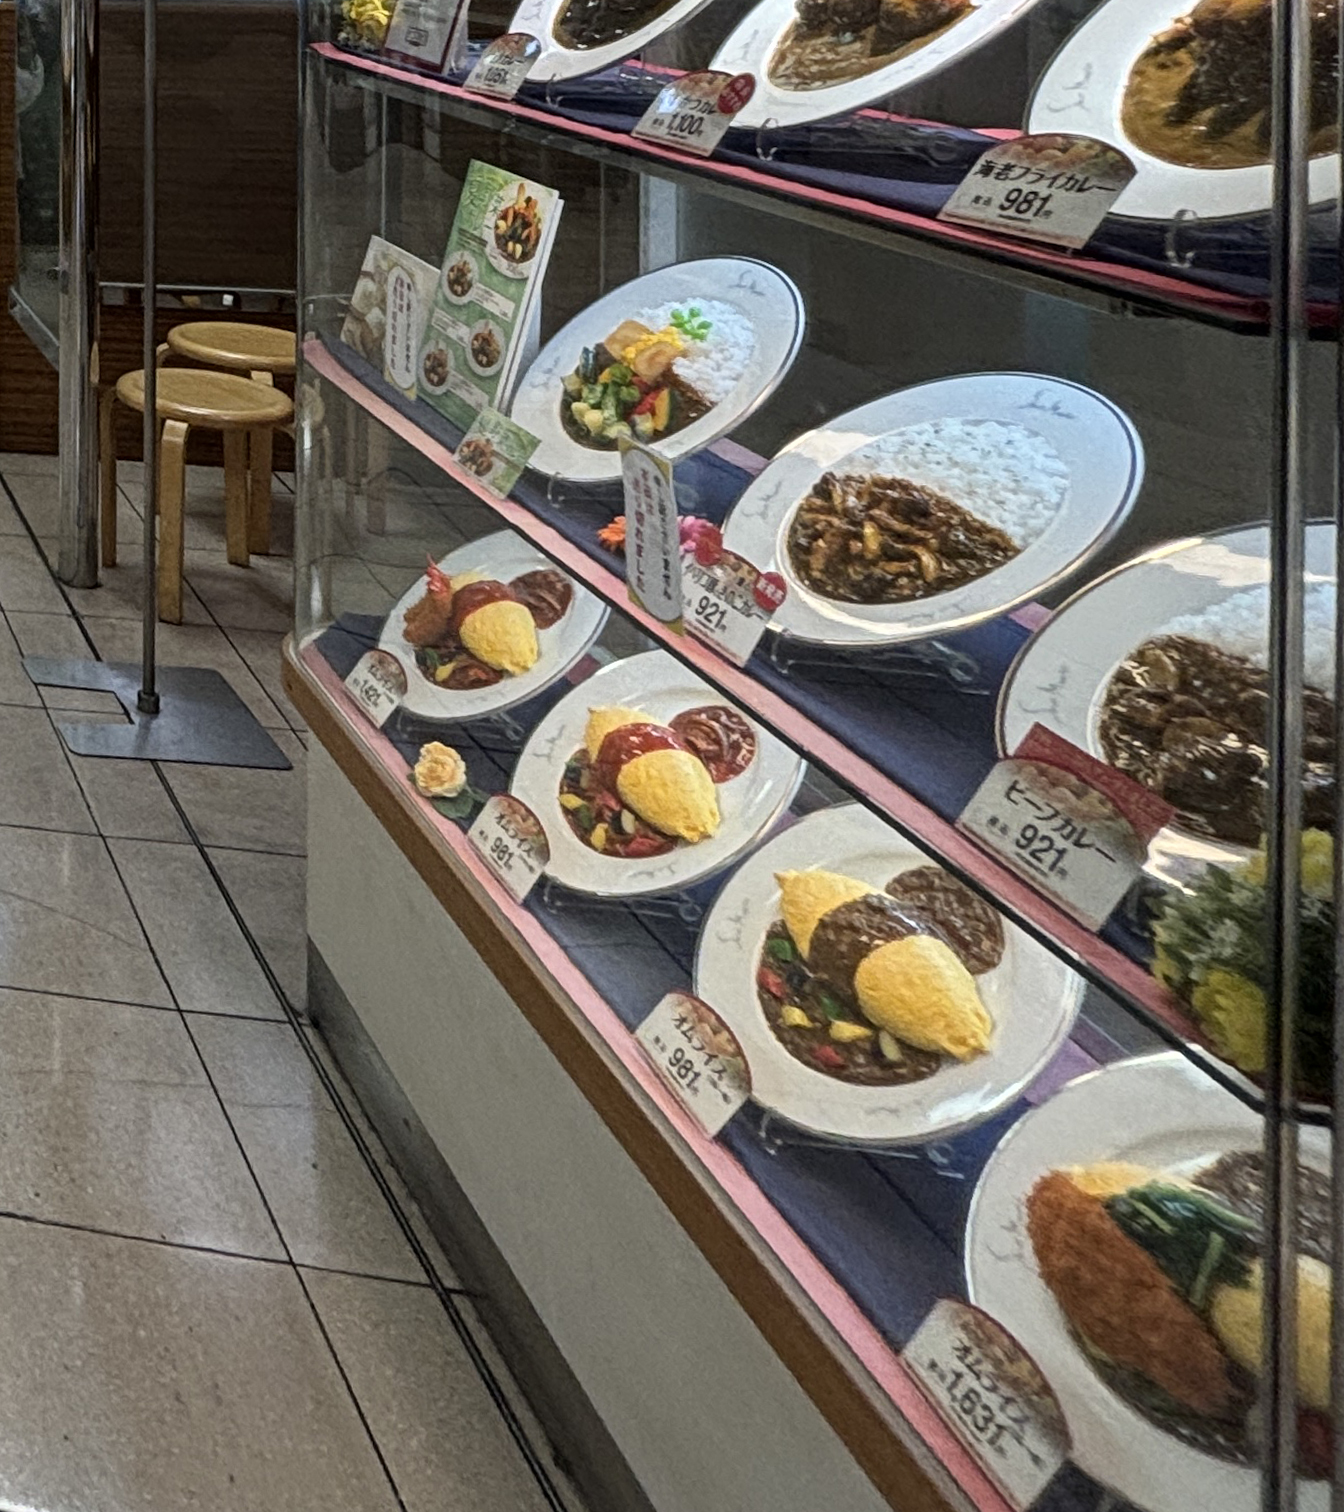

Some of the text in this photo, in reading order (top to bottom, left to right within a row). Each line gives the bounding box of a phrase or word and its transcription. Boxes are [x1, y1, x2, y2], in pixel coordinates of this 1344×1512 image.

[971, 159, 1119, 194] 海老フライカレー
[998, 187, 1054, 221] 981円
[495, 812, 534, 859] オムライス
[1004, 780, 1118, 864] ビーフカレー
[671, 1013, 728, 1082] オムライス
[951, 1338, 1030, 1424] オムライス
